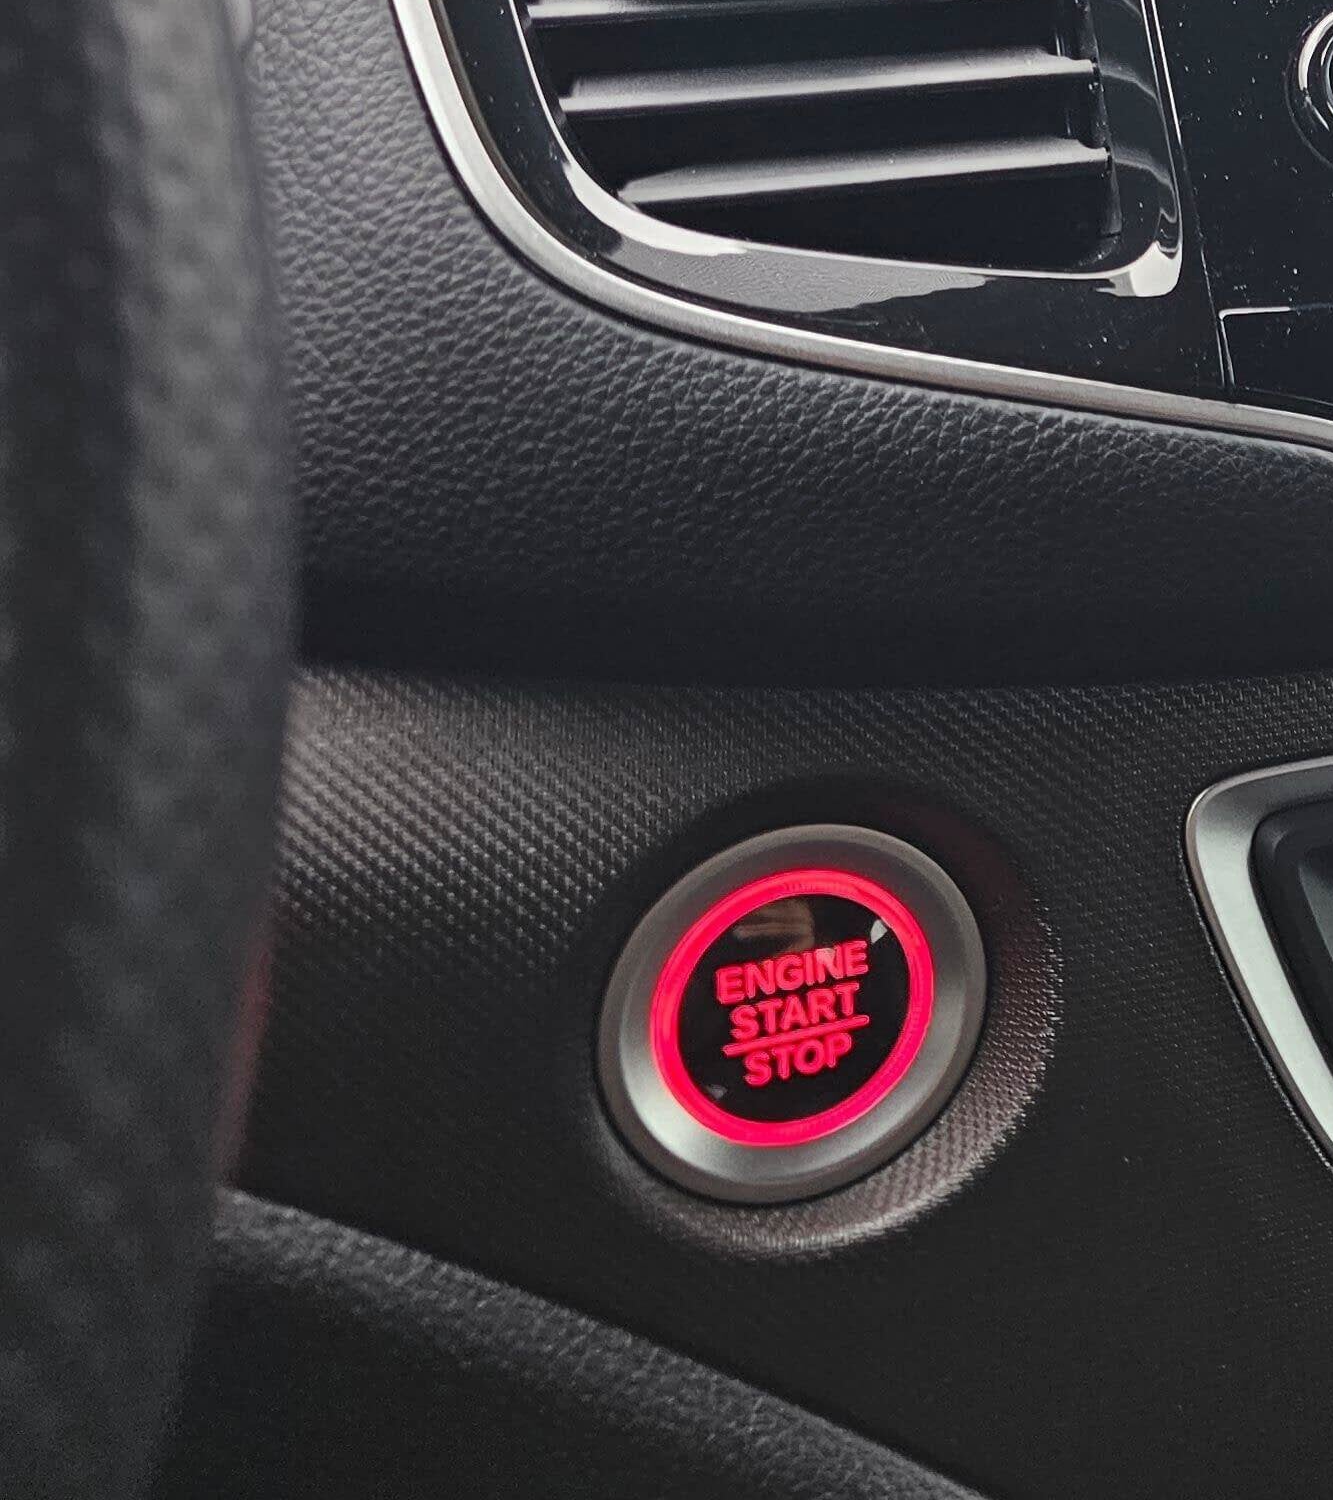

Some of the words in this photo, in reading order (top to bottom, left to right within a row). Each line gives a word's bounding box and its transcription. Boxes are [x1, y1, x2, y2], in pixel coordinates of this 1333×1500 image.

[716, 940, 869, 1004] ENGINE
[729, 983, 861, 1041] START
[743, 1033, 853, 1087] STOP
